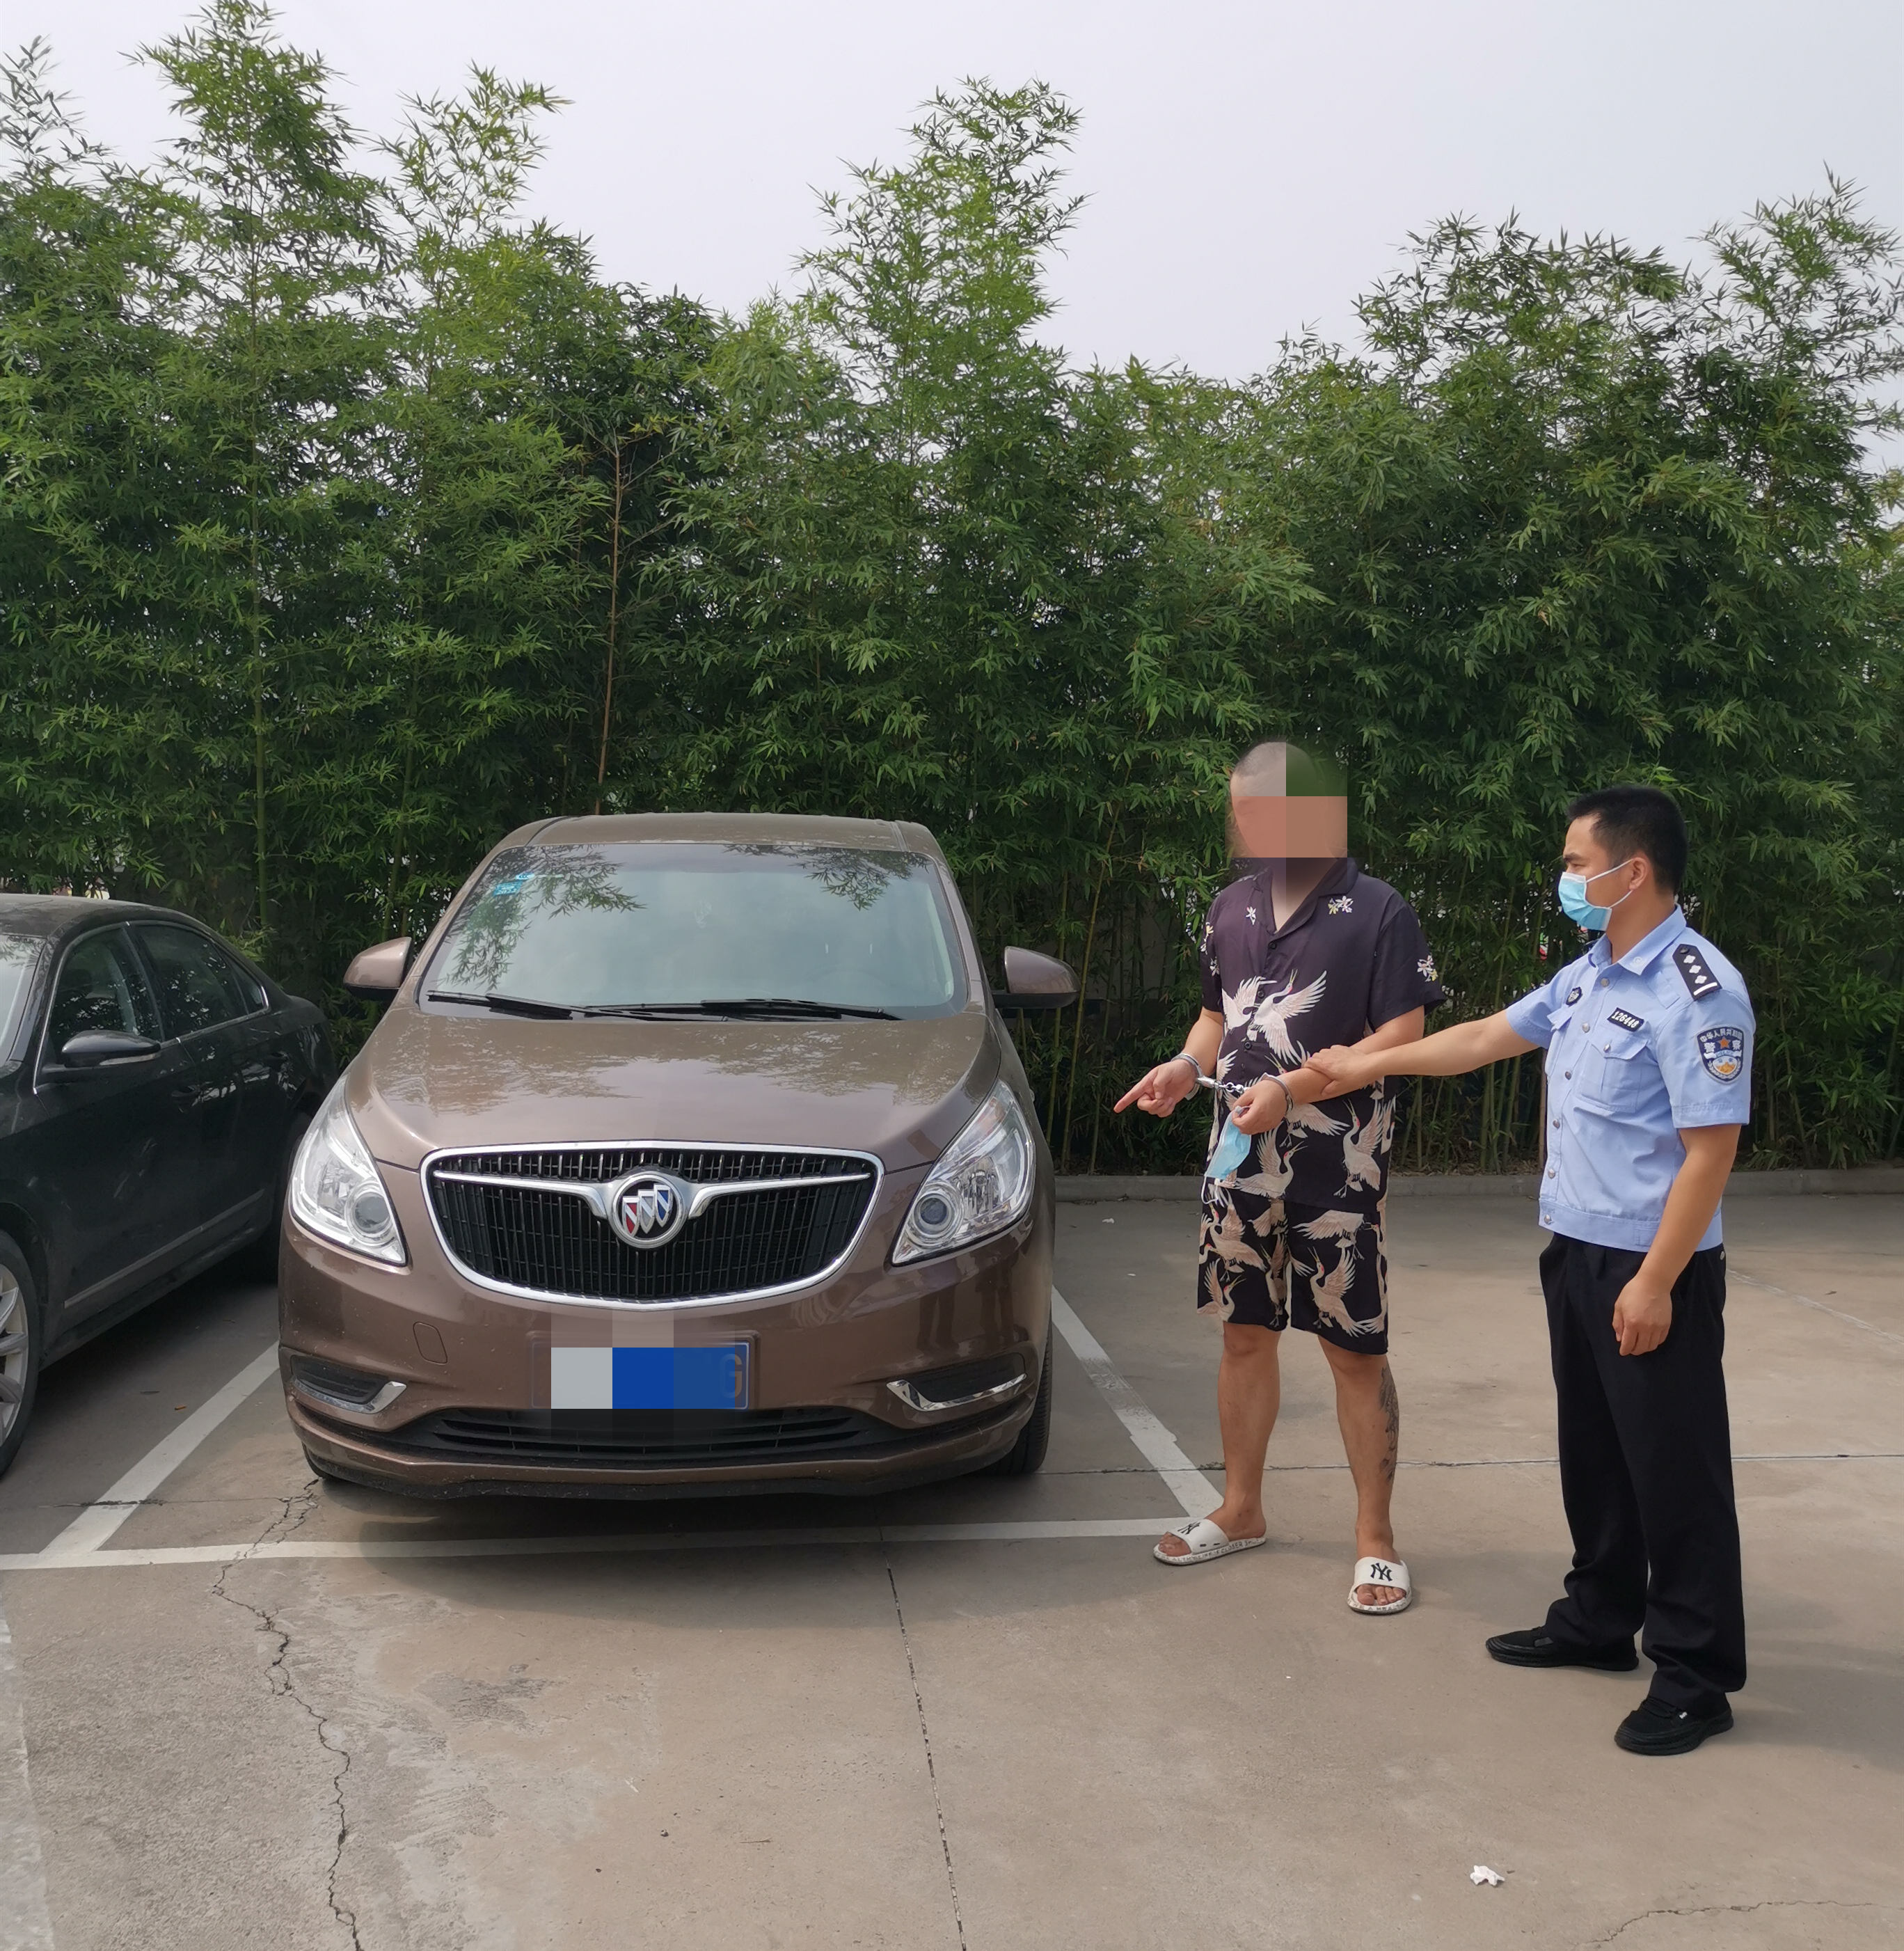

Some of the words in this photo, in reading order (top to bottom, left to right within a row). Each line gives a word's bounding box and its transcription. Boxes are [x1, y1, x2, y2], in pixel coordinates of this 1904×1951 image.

[1611, 1011, 1640, 1028] 126448
[1704, 1042, 1715, 1052] 警
[1732, 1040, 1740, 1050] 察
[1221, 1541, 1244, 1552] CLOSER
[1370, 1563, 1393, 1581] NY
